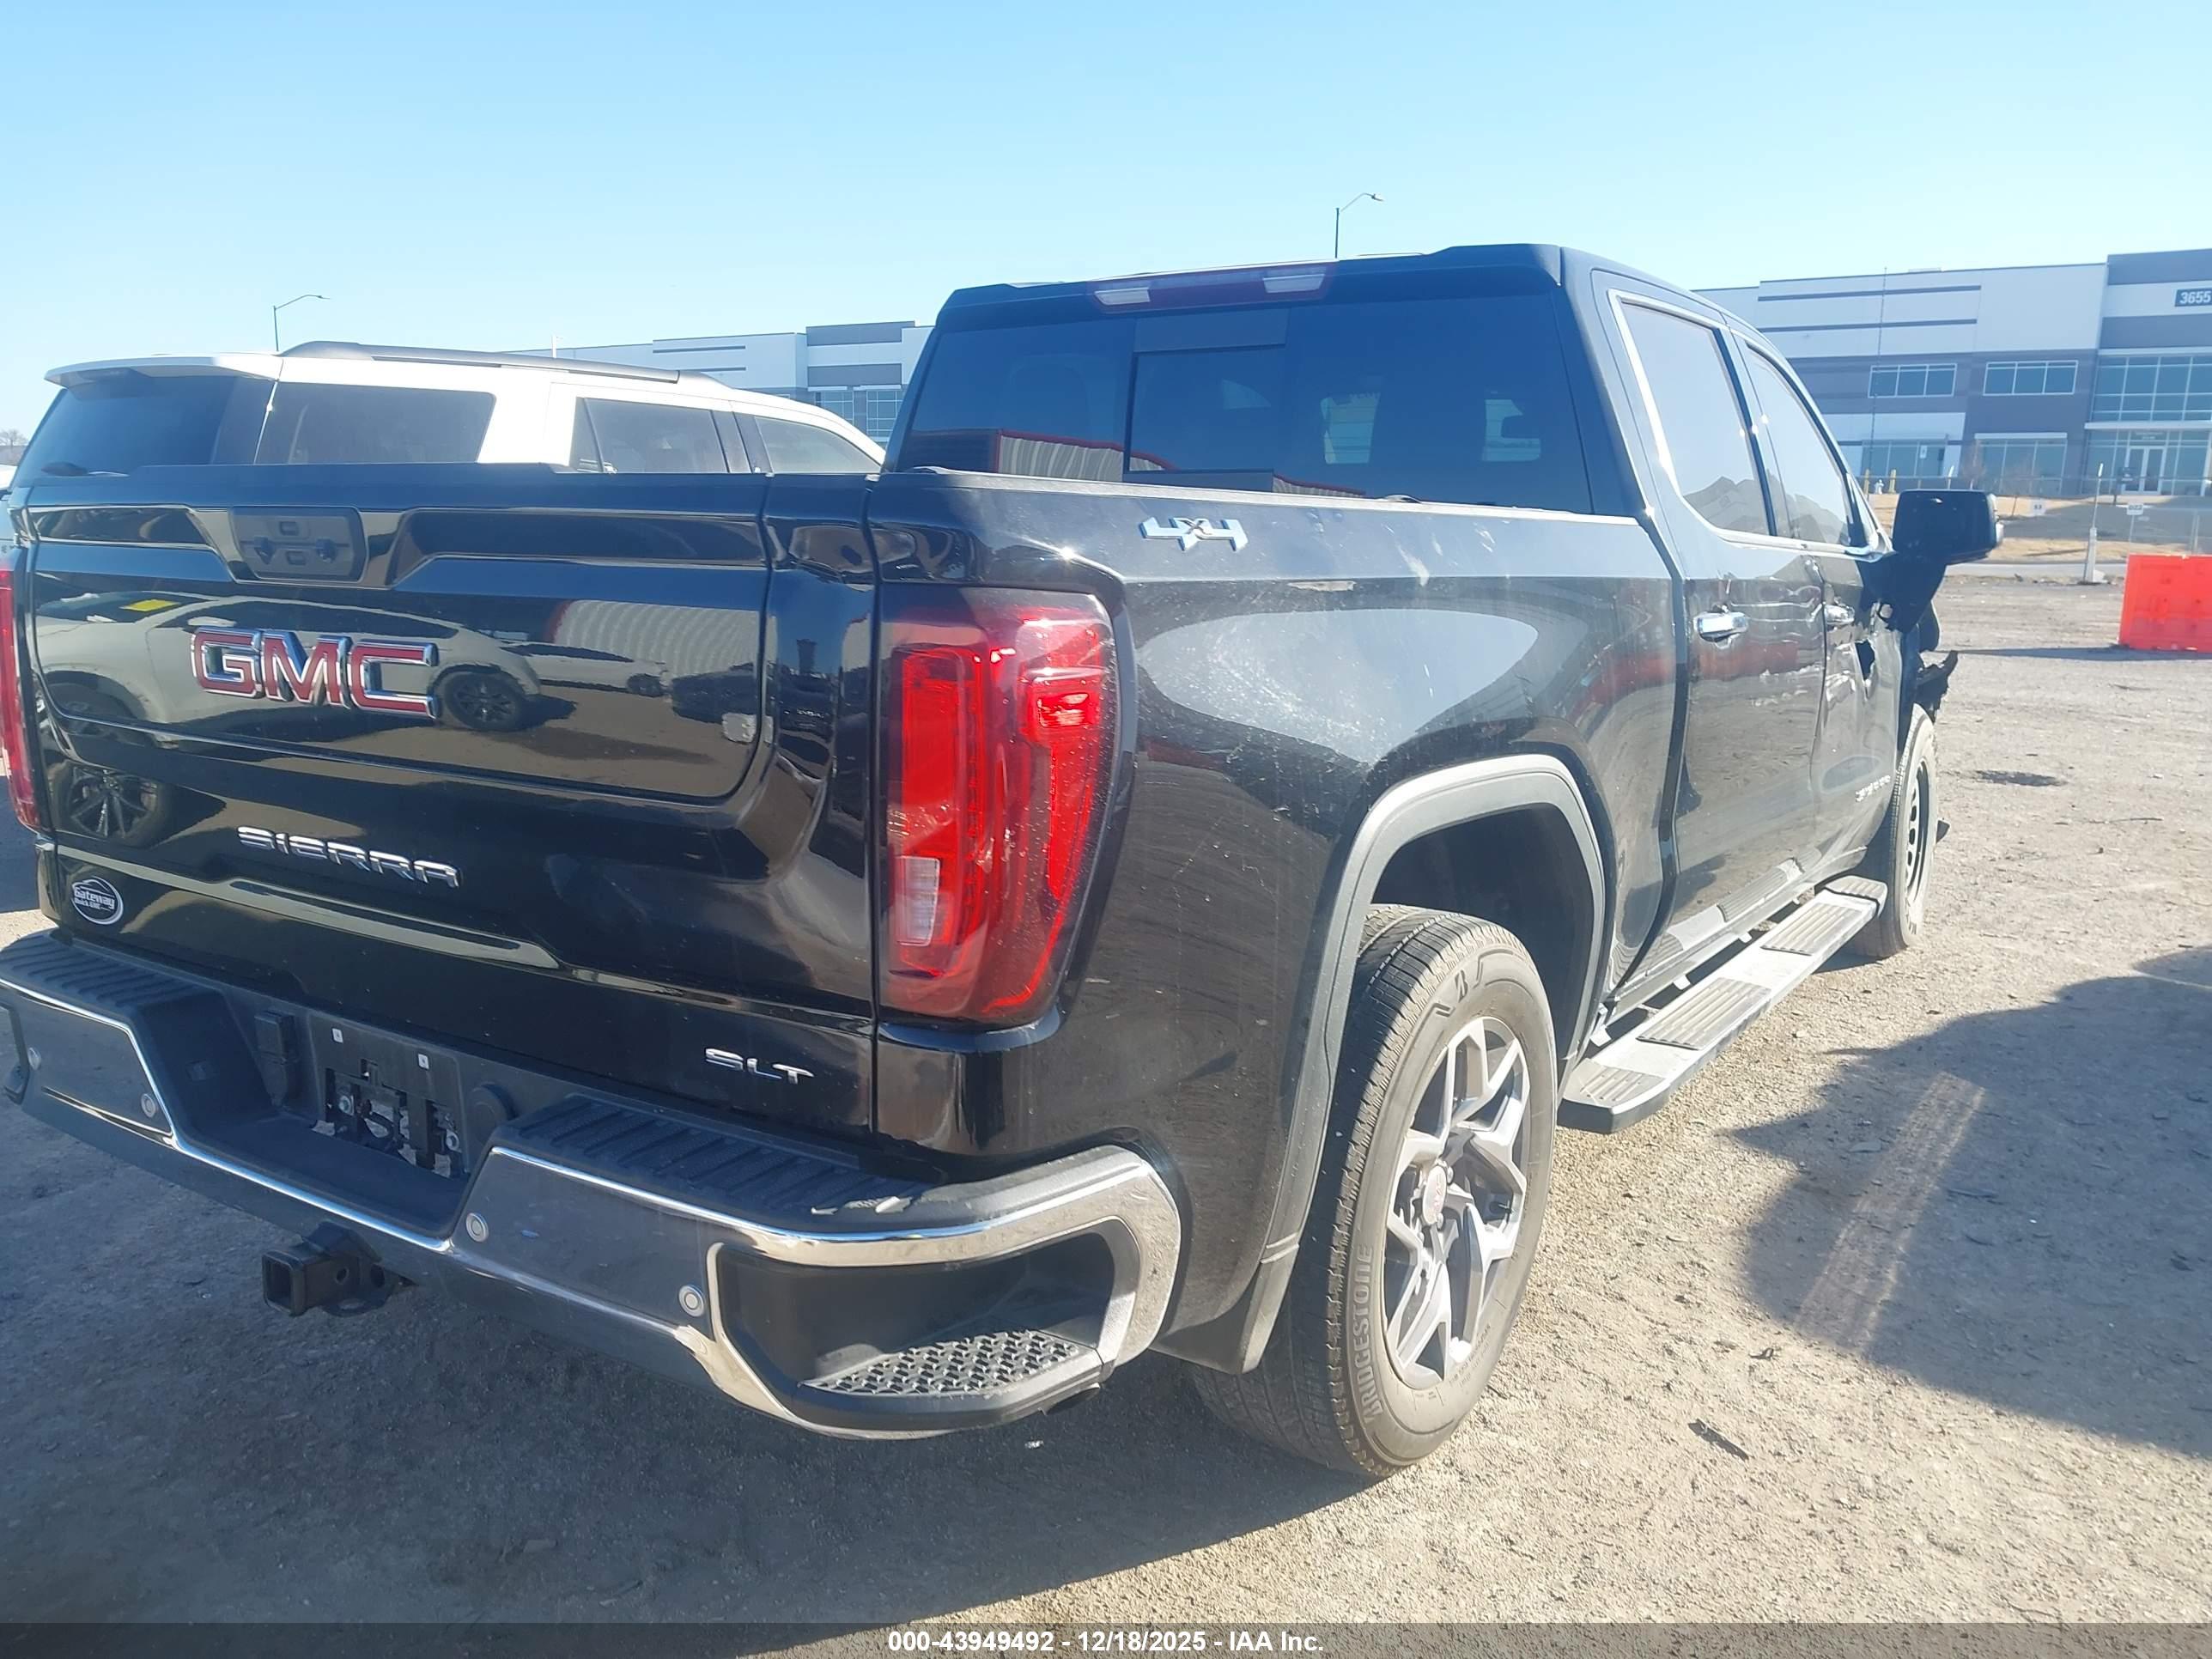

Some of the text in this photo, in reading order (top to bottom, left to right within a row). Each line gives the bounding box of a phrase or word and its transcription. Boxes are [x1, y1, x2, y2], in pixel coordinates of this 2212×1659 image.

[2179, 290, 2212, 304] 3655
[190, 626, 439, 720] GMC
[237, 825, 459, 888] SIERRA
[705, 1048, 815, 1085] SLT
[1352, 1245, 1384, 1425] BRIDGESTONE
